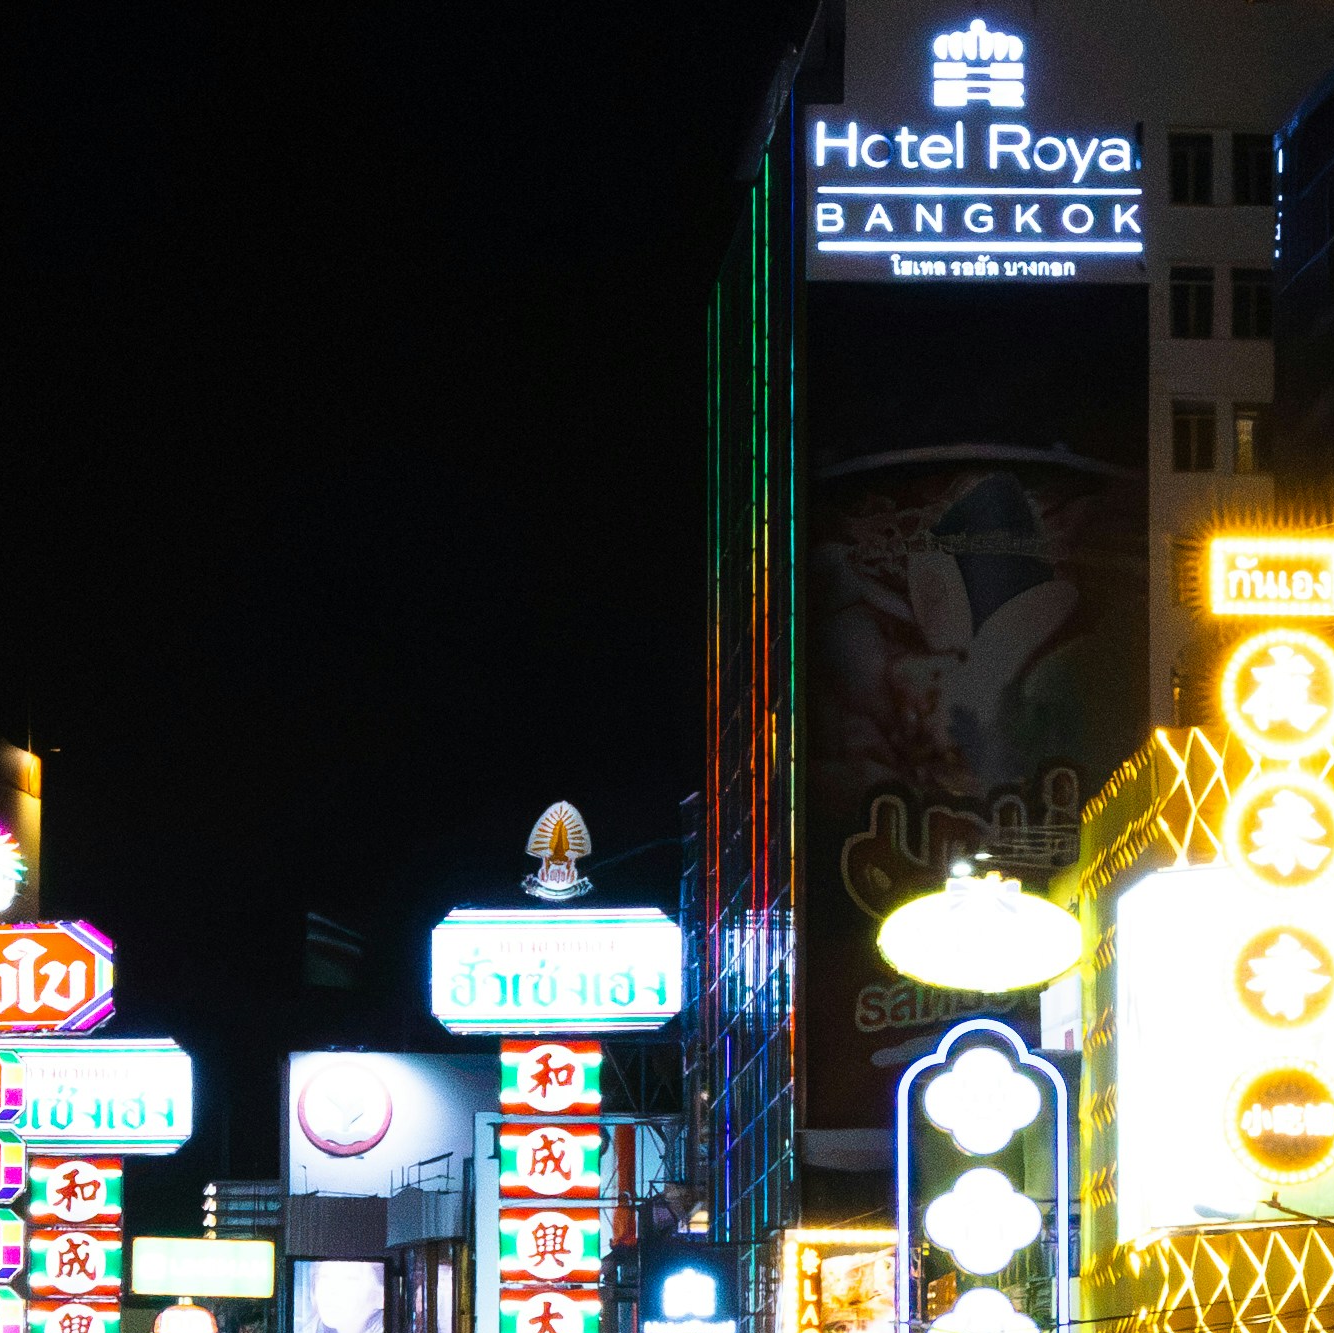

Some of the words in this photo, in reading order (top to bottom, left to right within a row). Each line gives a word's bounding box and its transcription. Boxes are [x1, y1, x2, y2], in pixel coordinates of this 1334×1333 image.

[815, 121, 963, 169] Hotel
[817, 204, 1141, 233] BANGKOK
[14, 1084, 175, 1131] เซ่งเฮง
